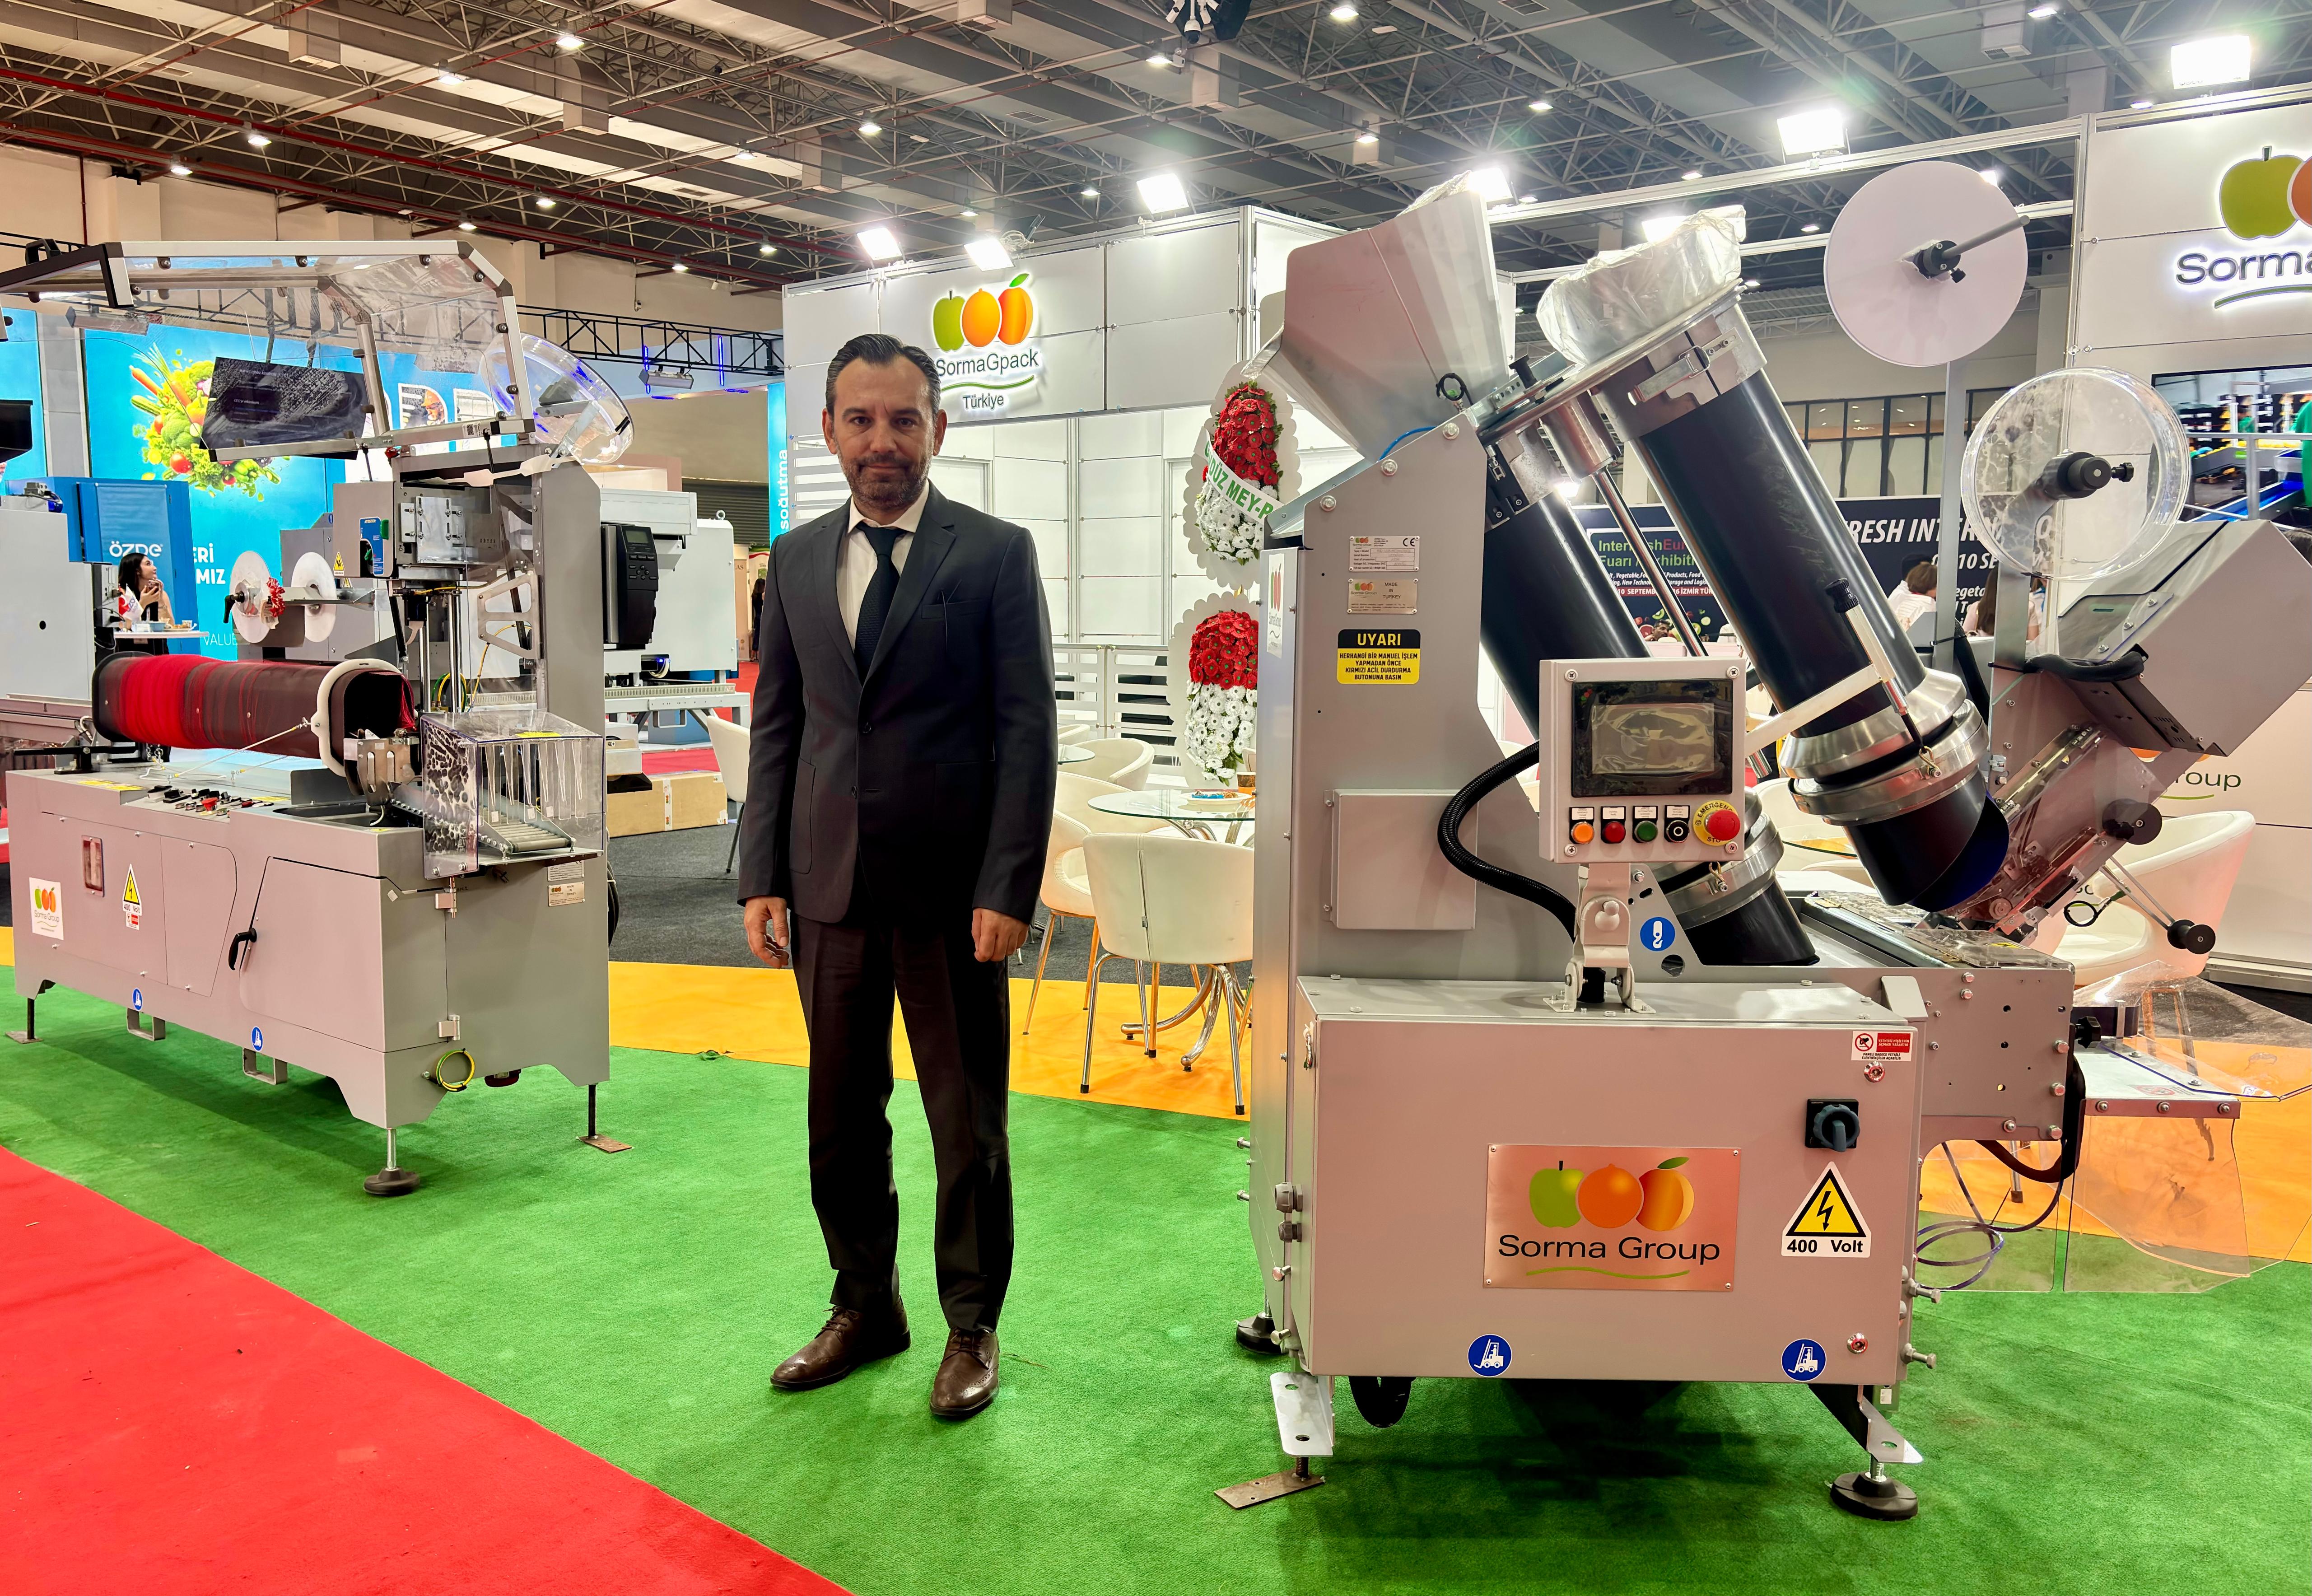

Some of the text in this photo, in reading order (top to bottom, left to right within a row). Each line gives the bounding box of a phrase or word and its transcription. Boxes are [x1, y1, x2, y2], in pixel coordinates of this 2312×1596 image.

[936, 348, 1039, 377] SormaGpack
[963, 393, 1004, 410] Türkiye
[778, 450, 789, 530] soğutma
[1357, 633, 1401, 646] UYARI
[1698, 803, 1733, 818] EMERGEN
[132, 905, 140, 914] Volt
[1498, 1234, 1720, 1265] Sorma Group
[1787, 1239, 1863, 1253] 400 Volt
